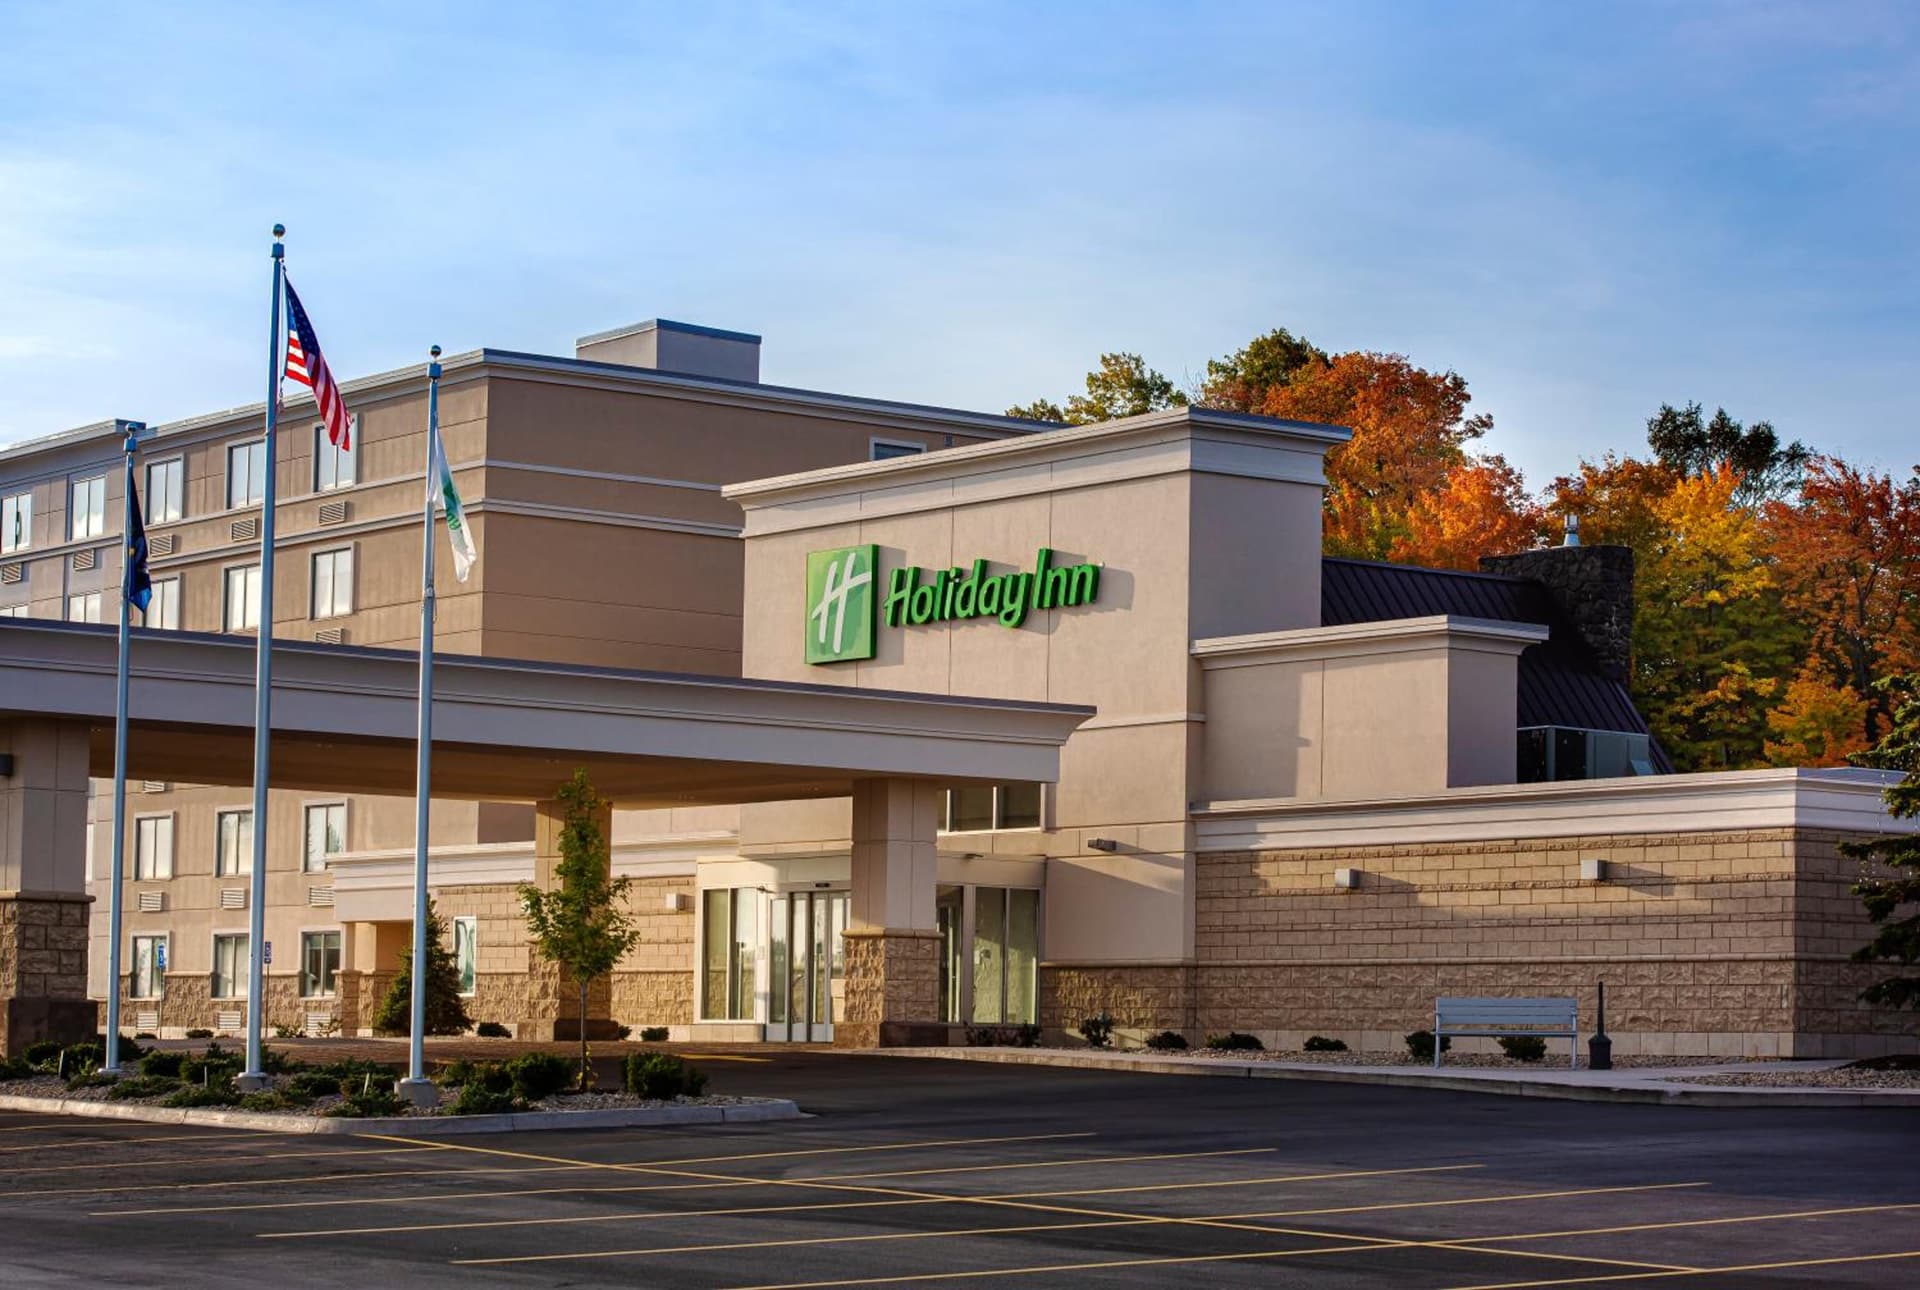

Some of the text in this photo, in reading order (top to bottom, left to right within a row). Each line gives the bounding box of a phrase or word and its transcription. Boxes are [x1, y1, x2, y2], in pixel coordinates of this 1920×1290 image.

[811, 552, 872, 653] H
[883, 547, 1100, 628] Holiday Inn
